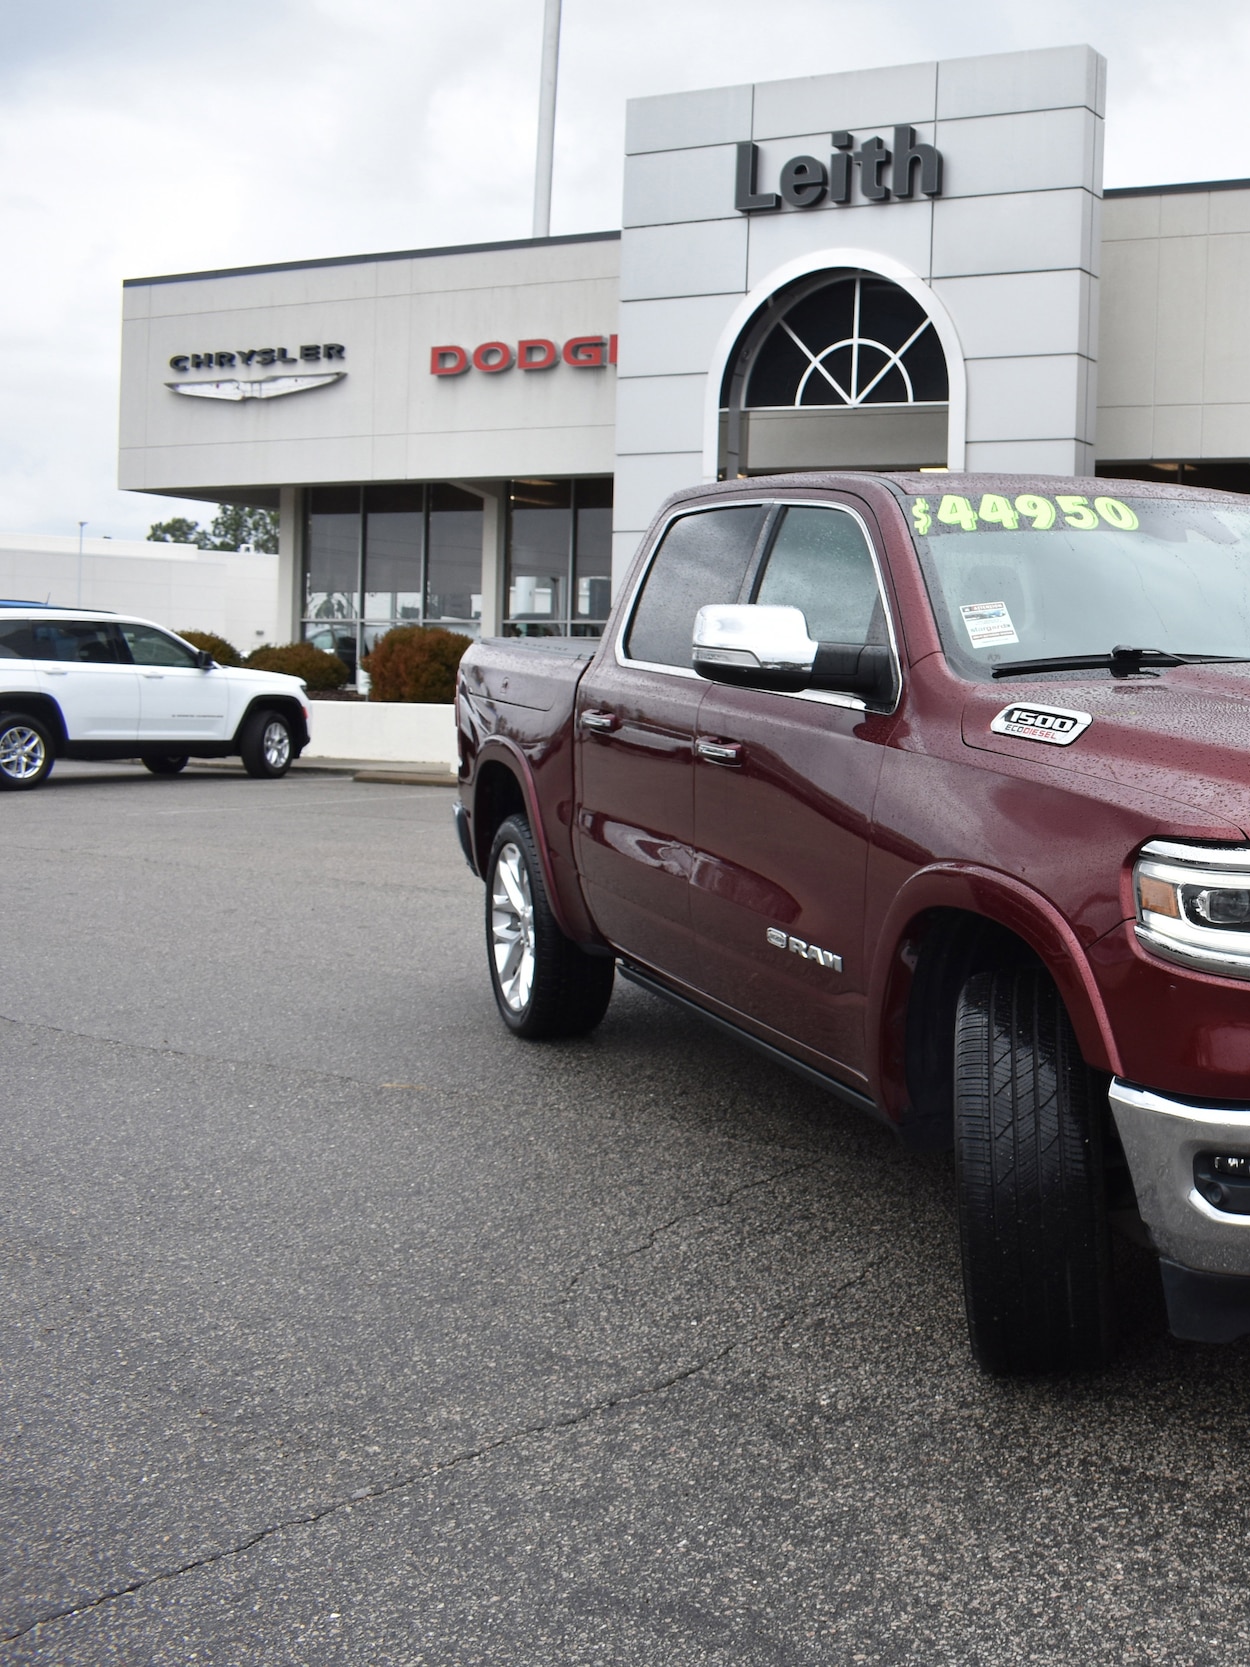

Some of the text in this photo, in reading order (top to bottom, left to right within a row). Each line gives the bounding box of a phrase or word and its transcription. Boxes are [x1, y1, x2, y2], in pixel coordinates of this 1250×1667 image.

[735, 125, 944, 212] Leith
[169, 343, 346, 371] CHRYSLER
[430, 334, 618, 376] DODG
[911, 493, 1140, 535] $44950
[1005, 724, 1057, 739] ECODIESEL
[1010, 710, 1075, 732] 1500
[788, 936, 843, 973] RAM
